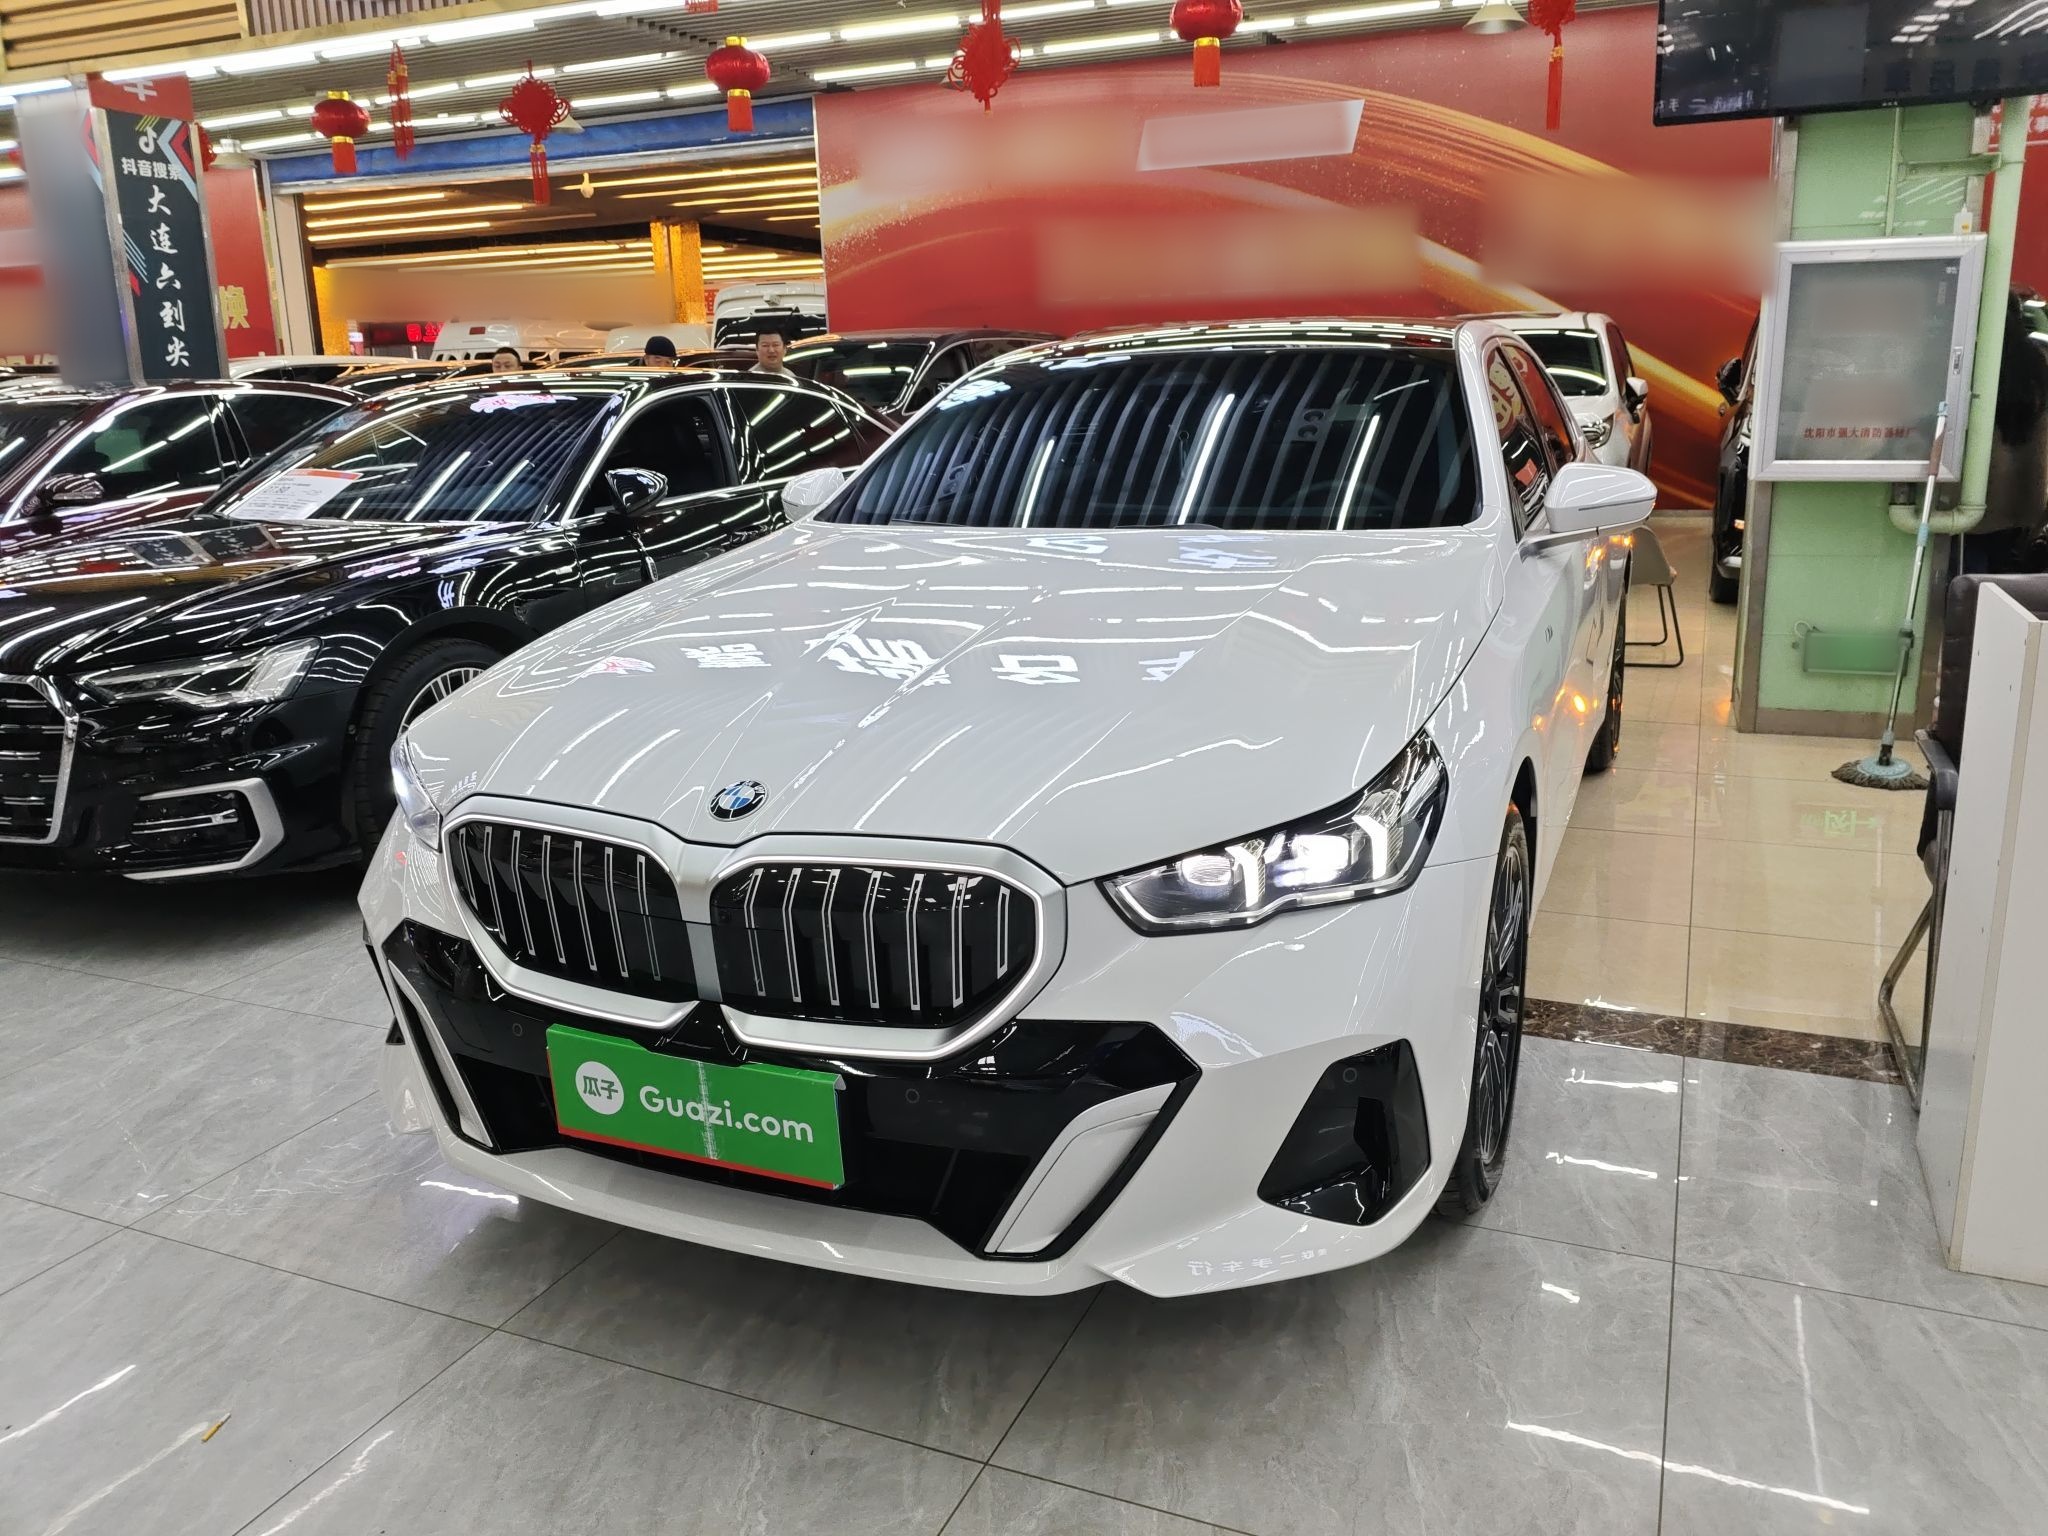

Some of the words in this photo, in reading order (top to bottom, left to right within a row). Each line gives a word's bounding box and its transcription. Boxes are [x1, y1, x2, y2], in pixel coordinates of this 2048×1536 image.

[121, 156, 182, 181] 抖音搜索
[583, 1074, 619, 1101] 瓜子
[639, 1085, 814, 1143] Guazi.com
